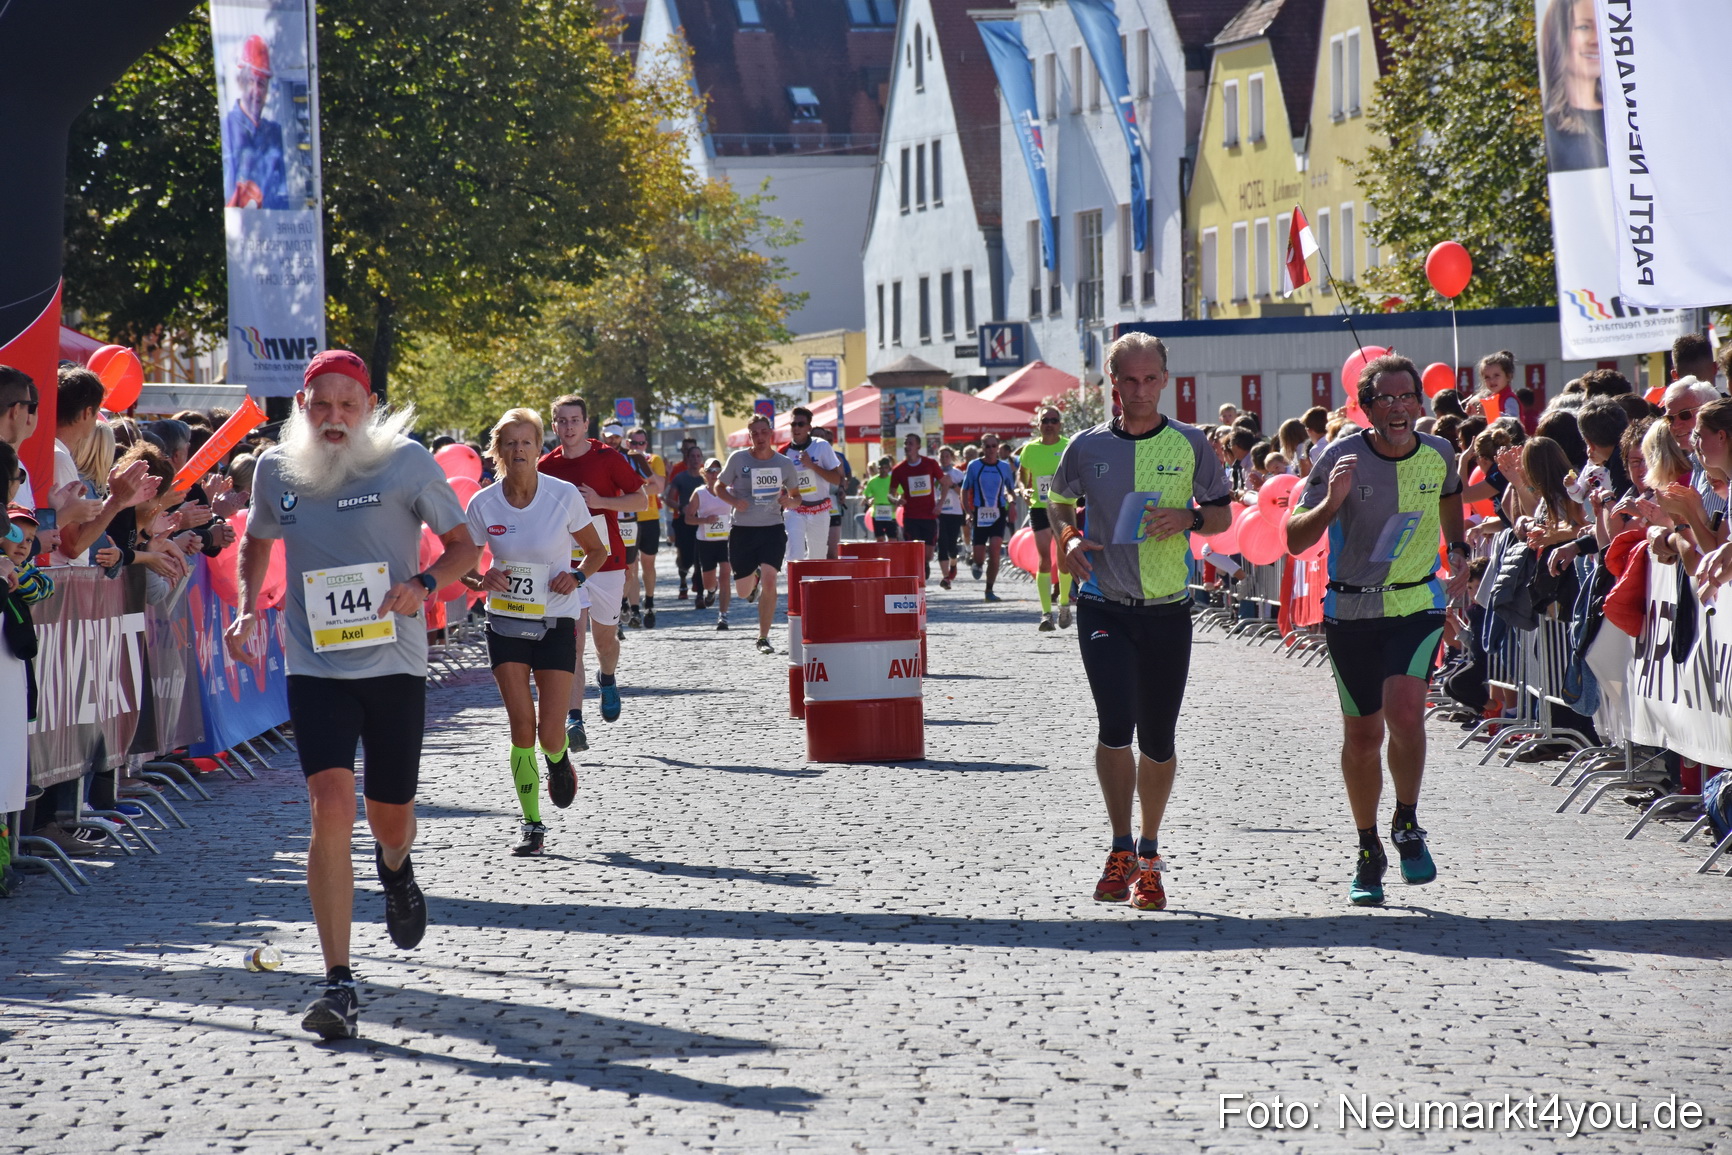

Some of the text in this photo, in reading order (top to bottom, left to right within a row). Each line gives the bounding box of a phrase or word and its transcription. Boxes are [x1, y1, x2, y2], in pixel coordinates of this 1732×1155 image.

[1239, 179, 1267, 211] HOTEL
[756, 475, 778, 485] 3009
[798, 476, 810, 486] 20
[913, 481, 927, 489] 335
[1040, 483, 1050, 492] 21
[337, 493, 380, 508] BOCK
[981, 512, 998, 520] 2116
[326, 572, 365, 586] BOCK
[325, 587, 372, 616] 144
[507, 602, 525, 613] Heidi
[343, 615, 370, 624] Neumarkt
[342, 627, 364, 641] Axel
